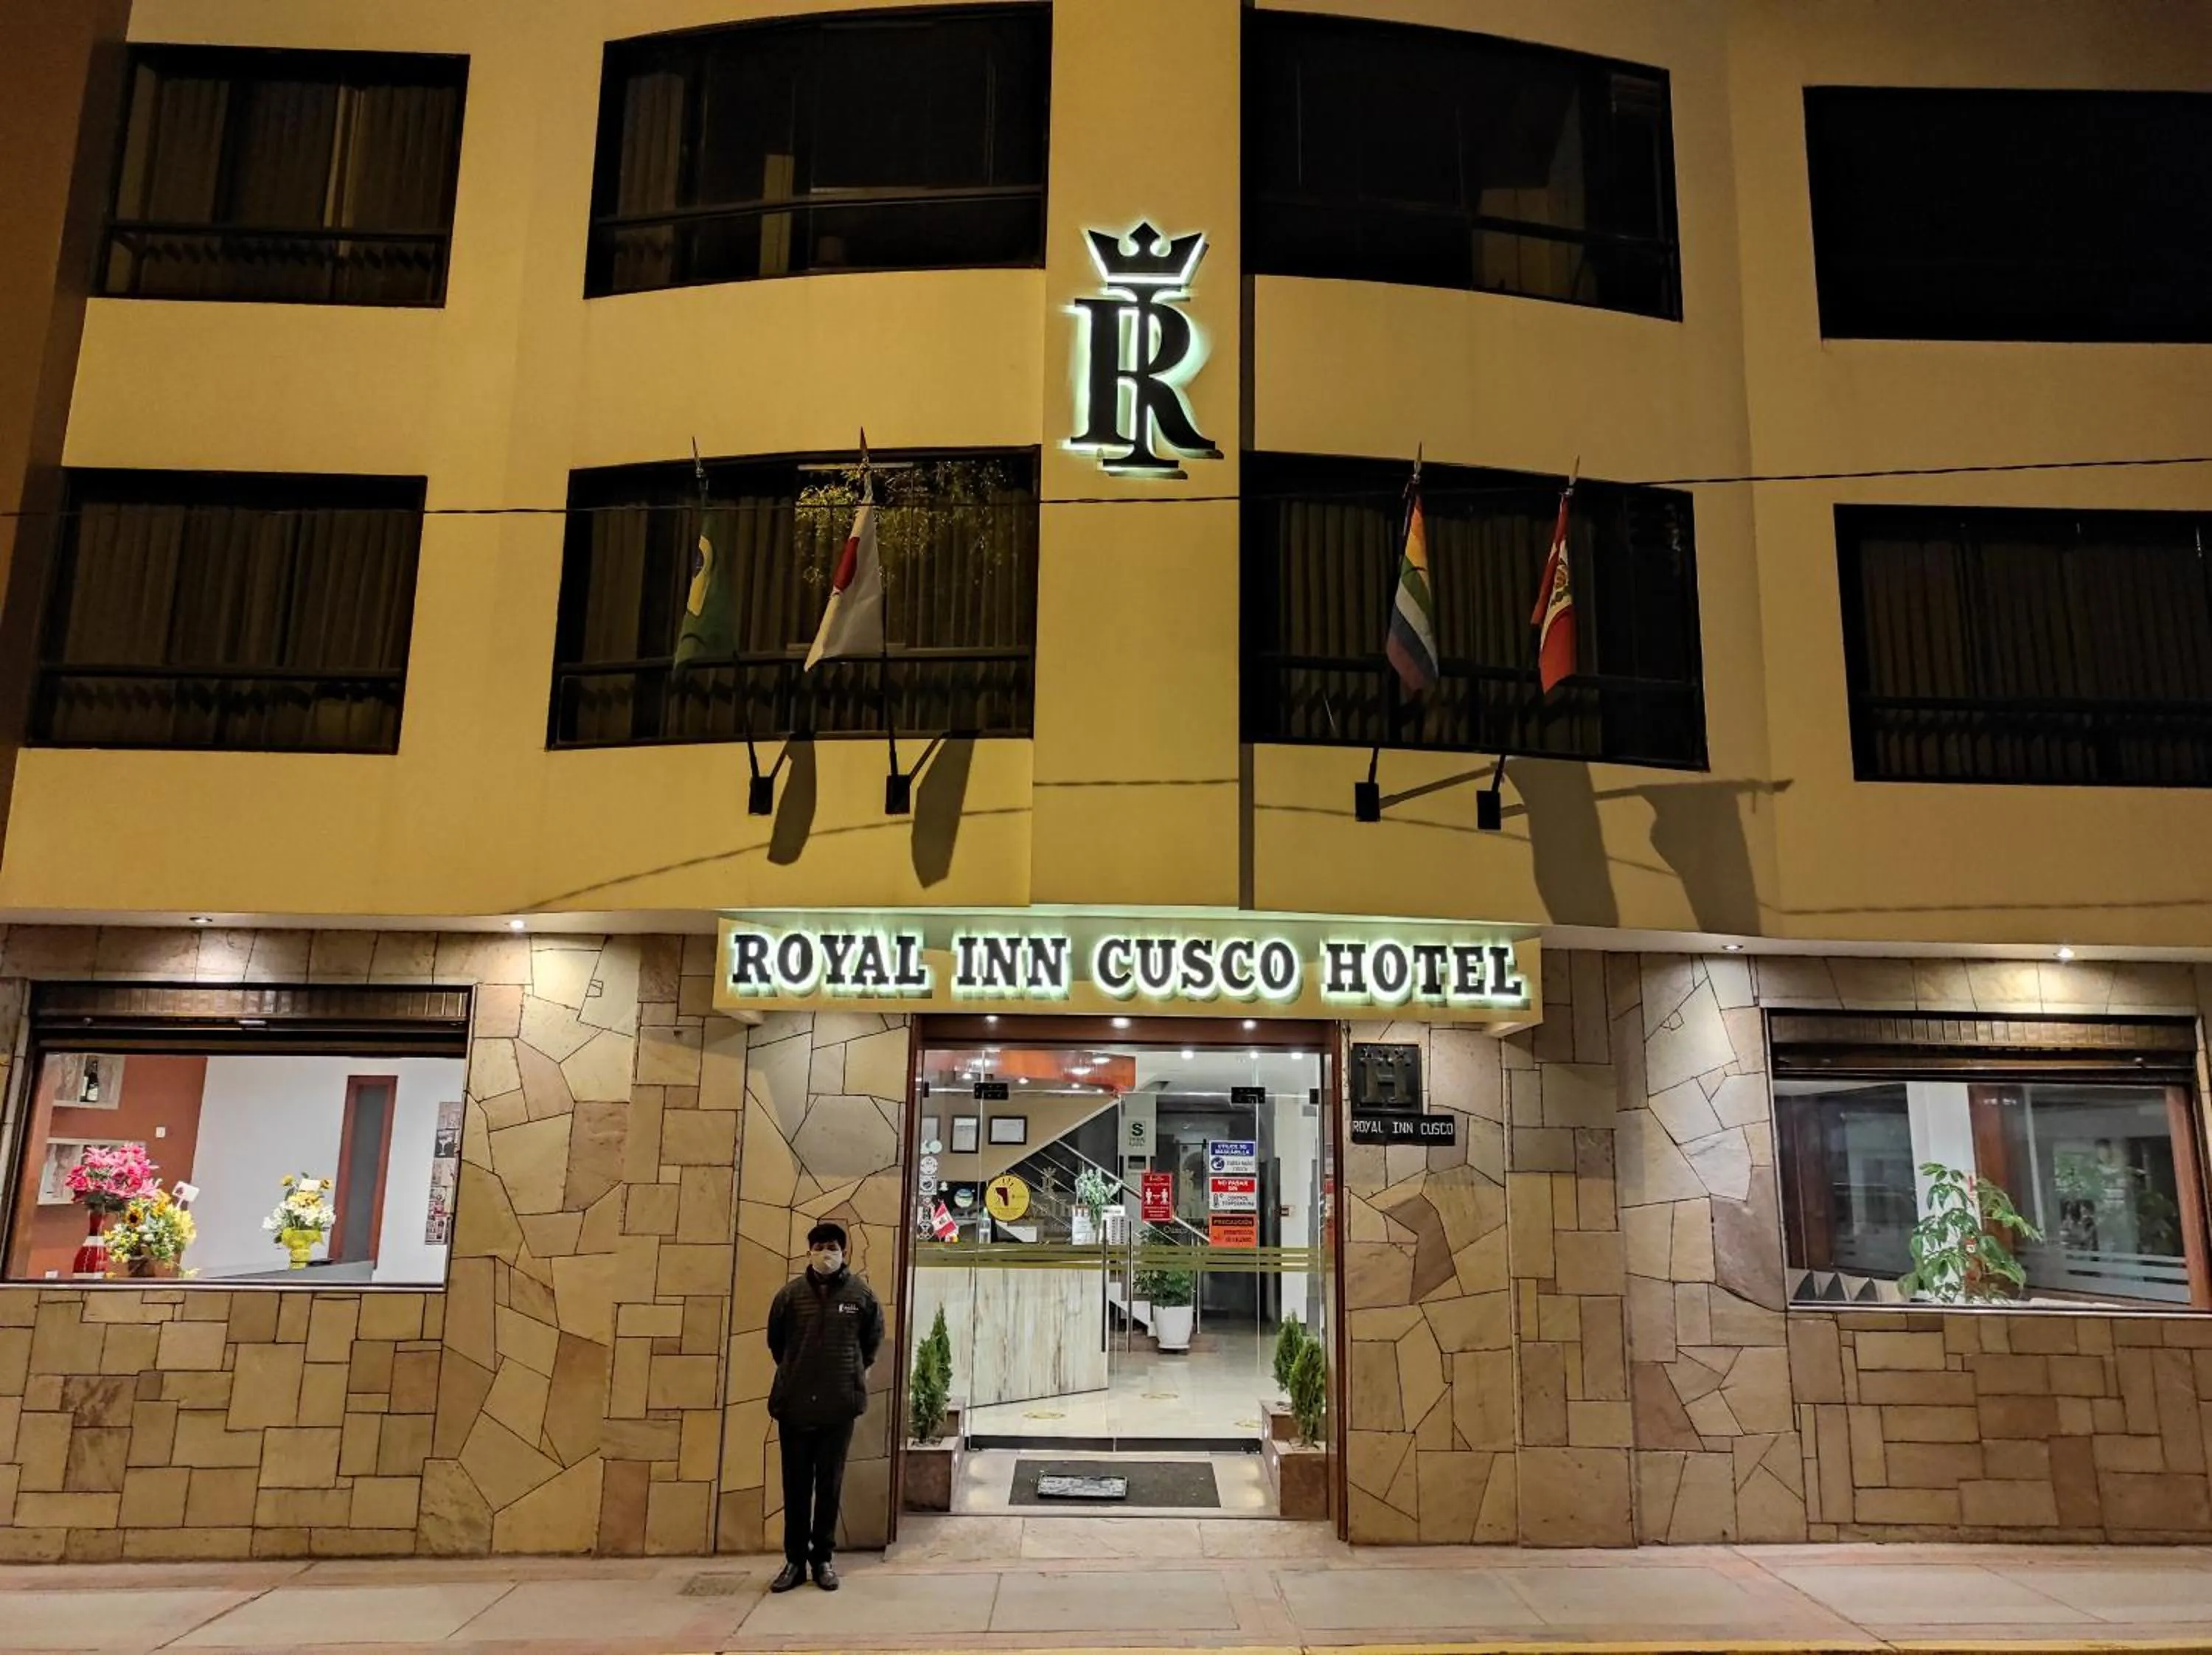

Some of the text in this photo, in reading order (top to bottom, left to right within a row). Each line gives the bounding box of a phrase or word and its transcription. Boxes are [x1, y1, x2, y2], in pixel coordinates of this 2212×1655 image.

[732, 934, 1522, 996] ROYAL INN CUSCO HOTEL
[1132, 1123, 1144, 1137] S
[1353, 1121, 1453, 1135] ROYAL INN CUSCO
